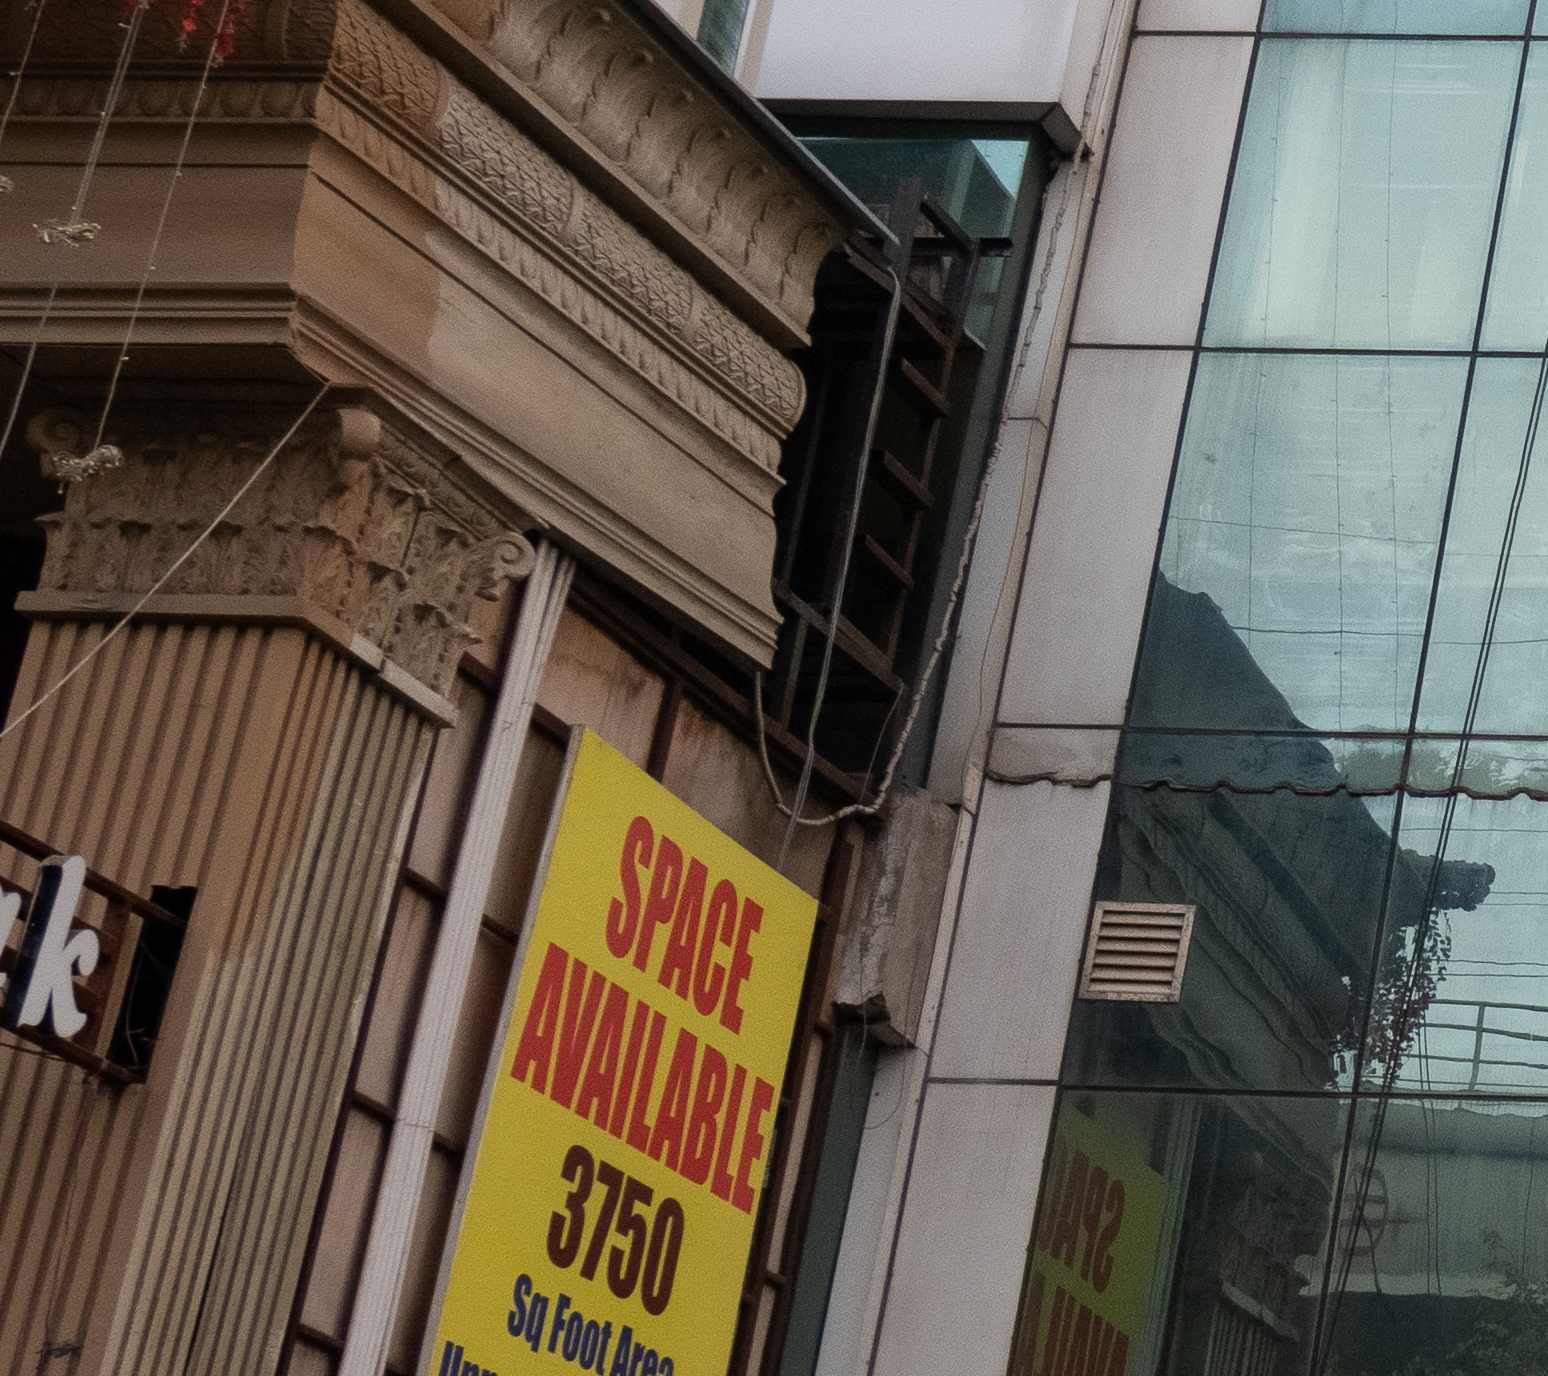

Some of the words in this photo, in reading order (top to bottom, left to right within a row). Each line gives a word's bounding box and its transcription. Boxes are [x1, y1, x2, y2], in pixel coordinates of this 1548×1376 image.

[606, 815, 765, 1036] SPACE
[510, 941, 776, 1215] AVAILABLE
[508, 1273, 549, 1355] Sq
[548, 1293, 613, 1376] Foot
[546, 1145, 685, 1317] 3750
